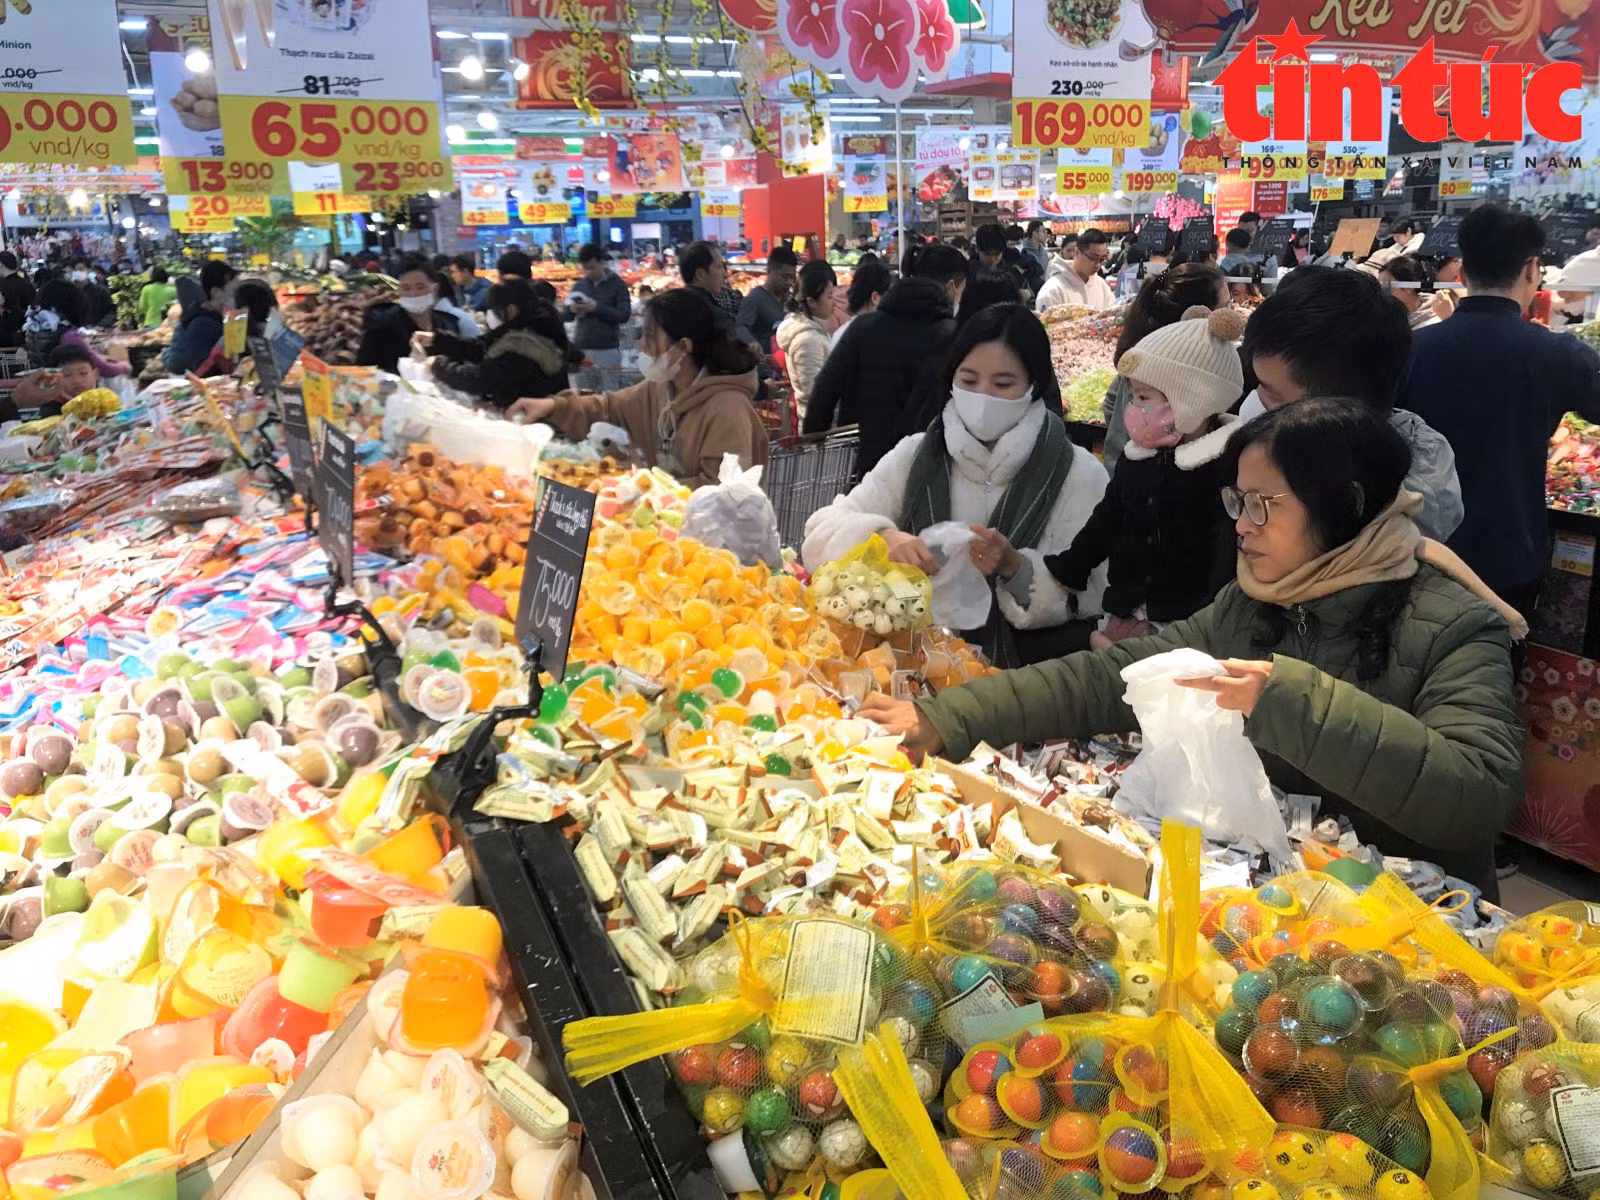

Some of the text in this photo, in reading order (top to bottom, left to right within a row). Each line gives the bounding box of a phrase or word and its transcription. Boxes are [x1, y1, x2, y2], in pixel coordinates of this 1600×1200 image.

[1016, 102, 1143, 146] 169.000
[29, 135, 110, 160] vnd/kg
[352, 140, 421, 160] vnd/kg
[1092, 131, 1136, 147] vnd/kg
